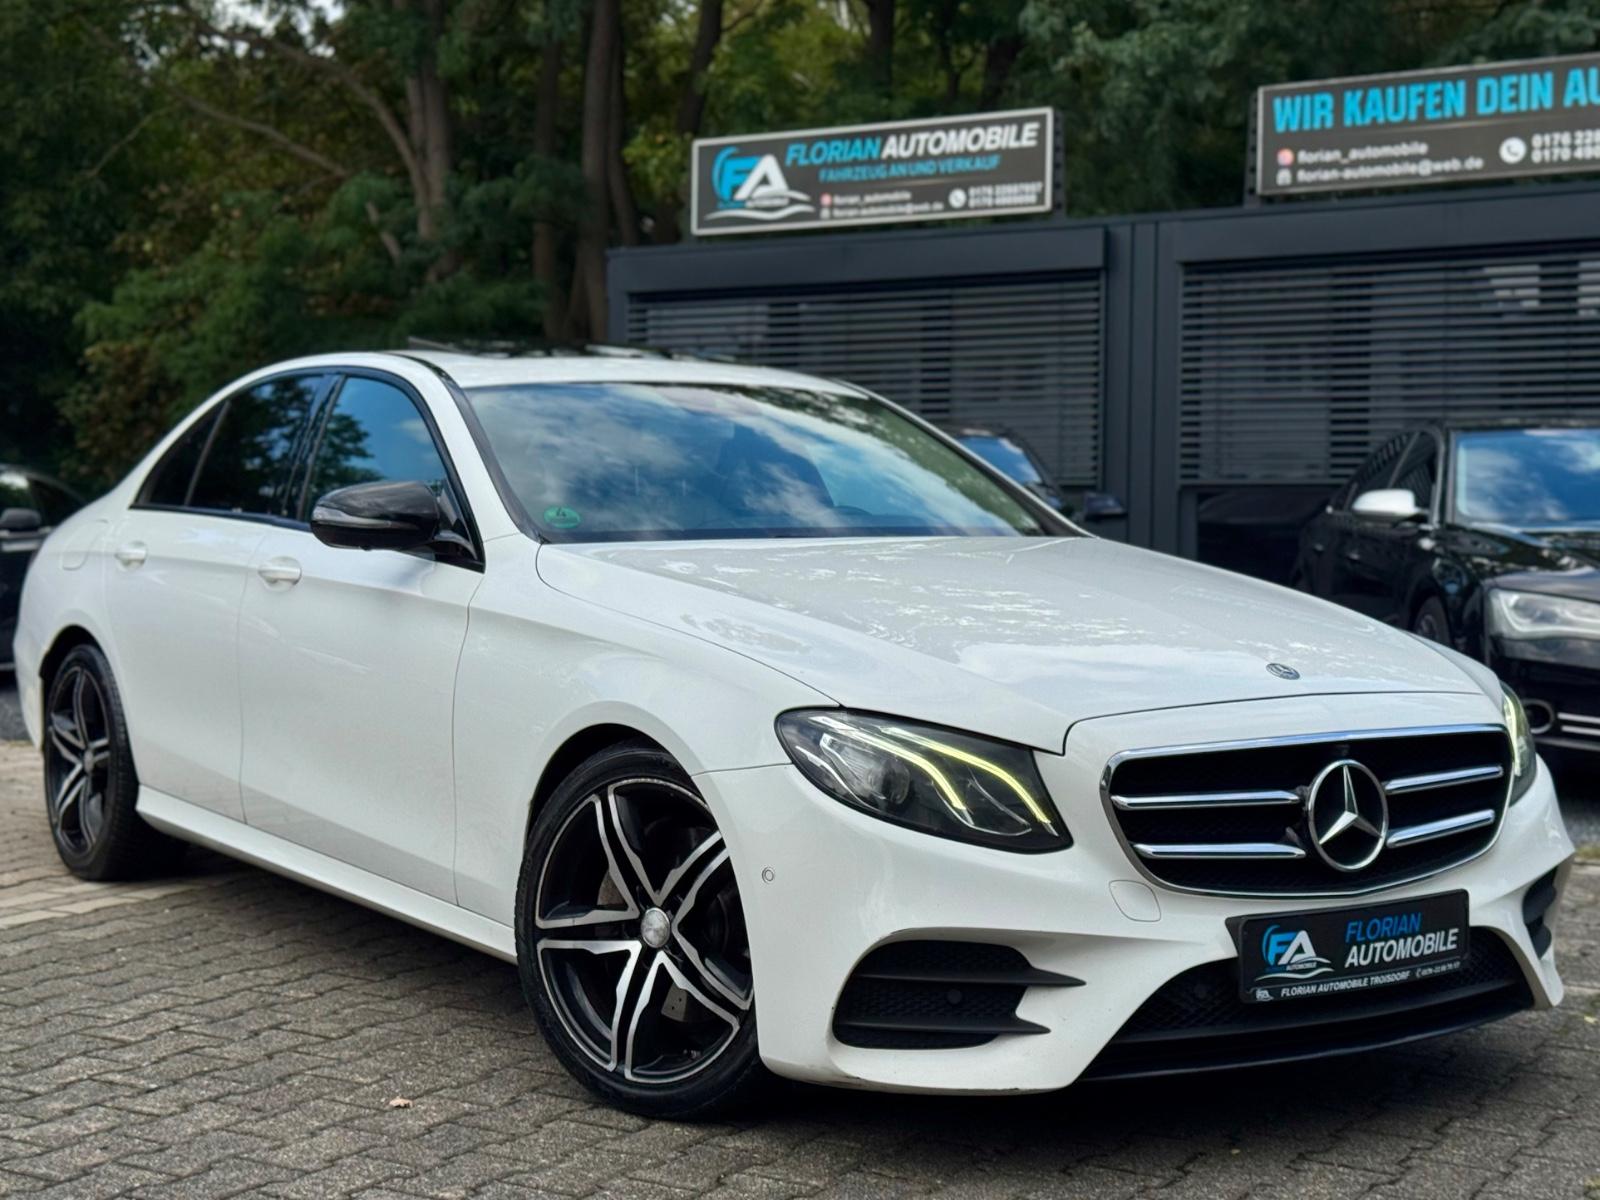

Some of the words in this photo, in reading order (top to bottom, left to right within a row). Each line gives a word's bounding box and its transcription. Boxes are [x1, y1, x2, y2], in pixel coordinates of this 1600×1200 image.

[1273, 93, 1334, 133] WIR
[1344, 80, 1466, 127] KAUFEN
[1476, 72, 1554, 115] DEIN
[785, 137, 881, 166] FLORIAN
[881, 123, 1039, 160] AUTOMOBILE
[1297, 142, 1428, 164] florian_automobile
[1345, 911, 1422, 943] FLORIAN
[1344, 928, 1459, 969] AUTOMOBILE
[1281, 984, 1317, 997] FLORIAN
[1317, 977, 1368, 993] AUTOMOBILE
